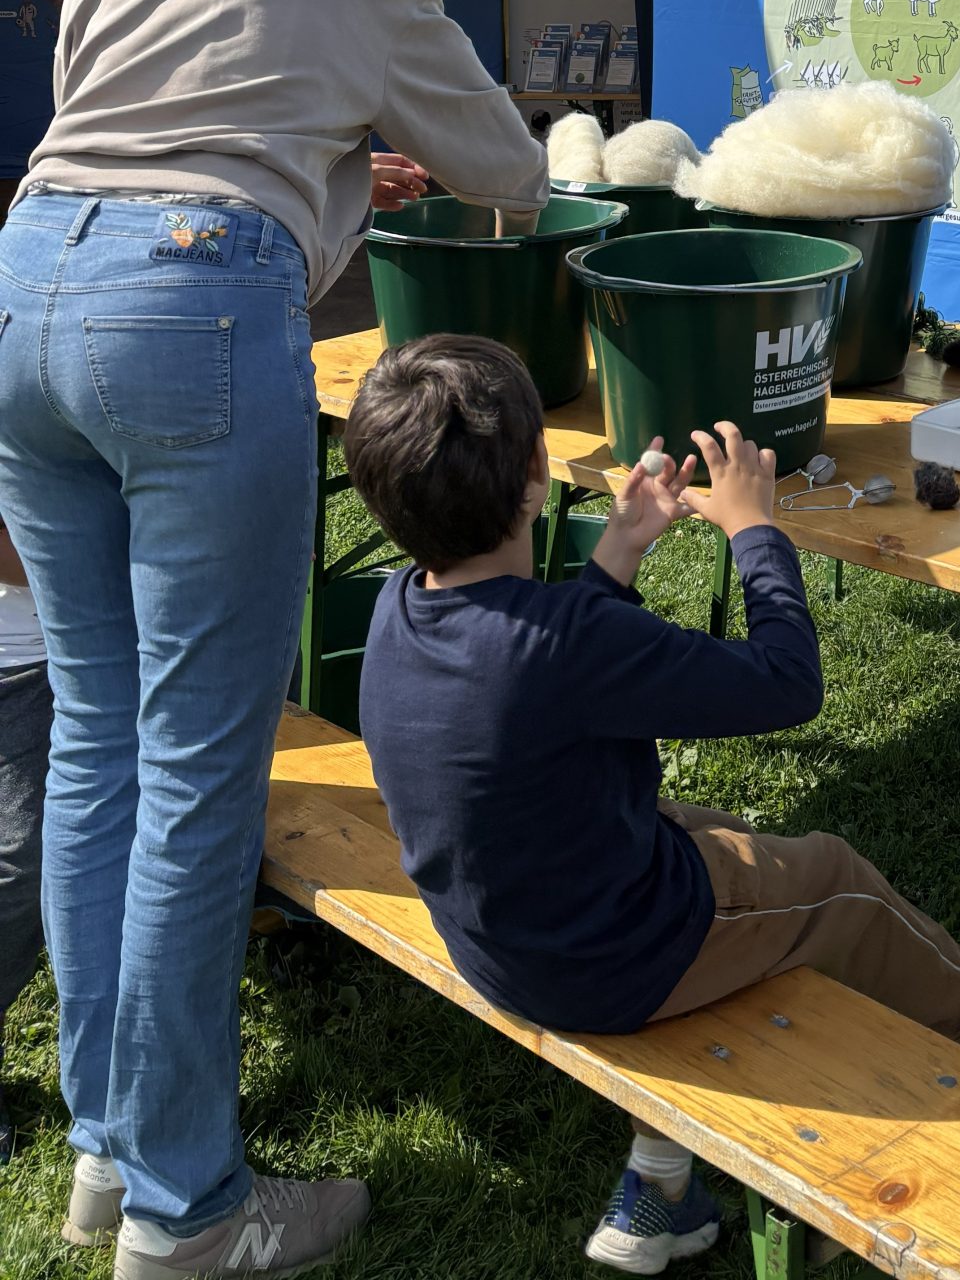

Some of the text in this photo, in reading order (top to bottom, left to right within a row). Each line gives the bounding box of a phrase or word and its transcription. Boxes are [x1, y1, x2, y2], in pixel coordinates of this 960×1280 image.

[754, 356, 829, 385] ÖSTERREICHISCHE
[774, 417, 818, 438] www.hagel.at
[81, 1168, 112, 1185] balance
[88, 1165, 106, 1175] new
